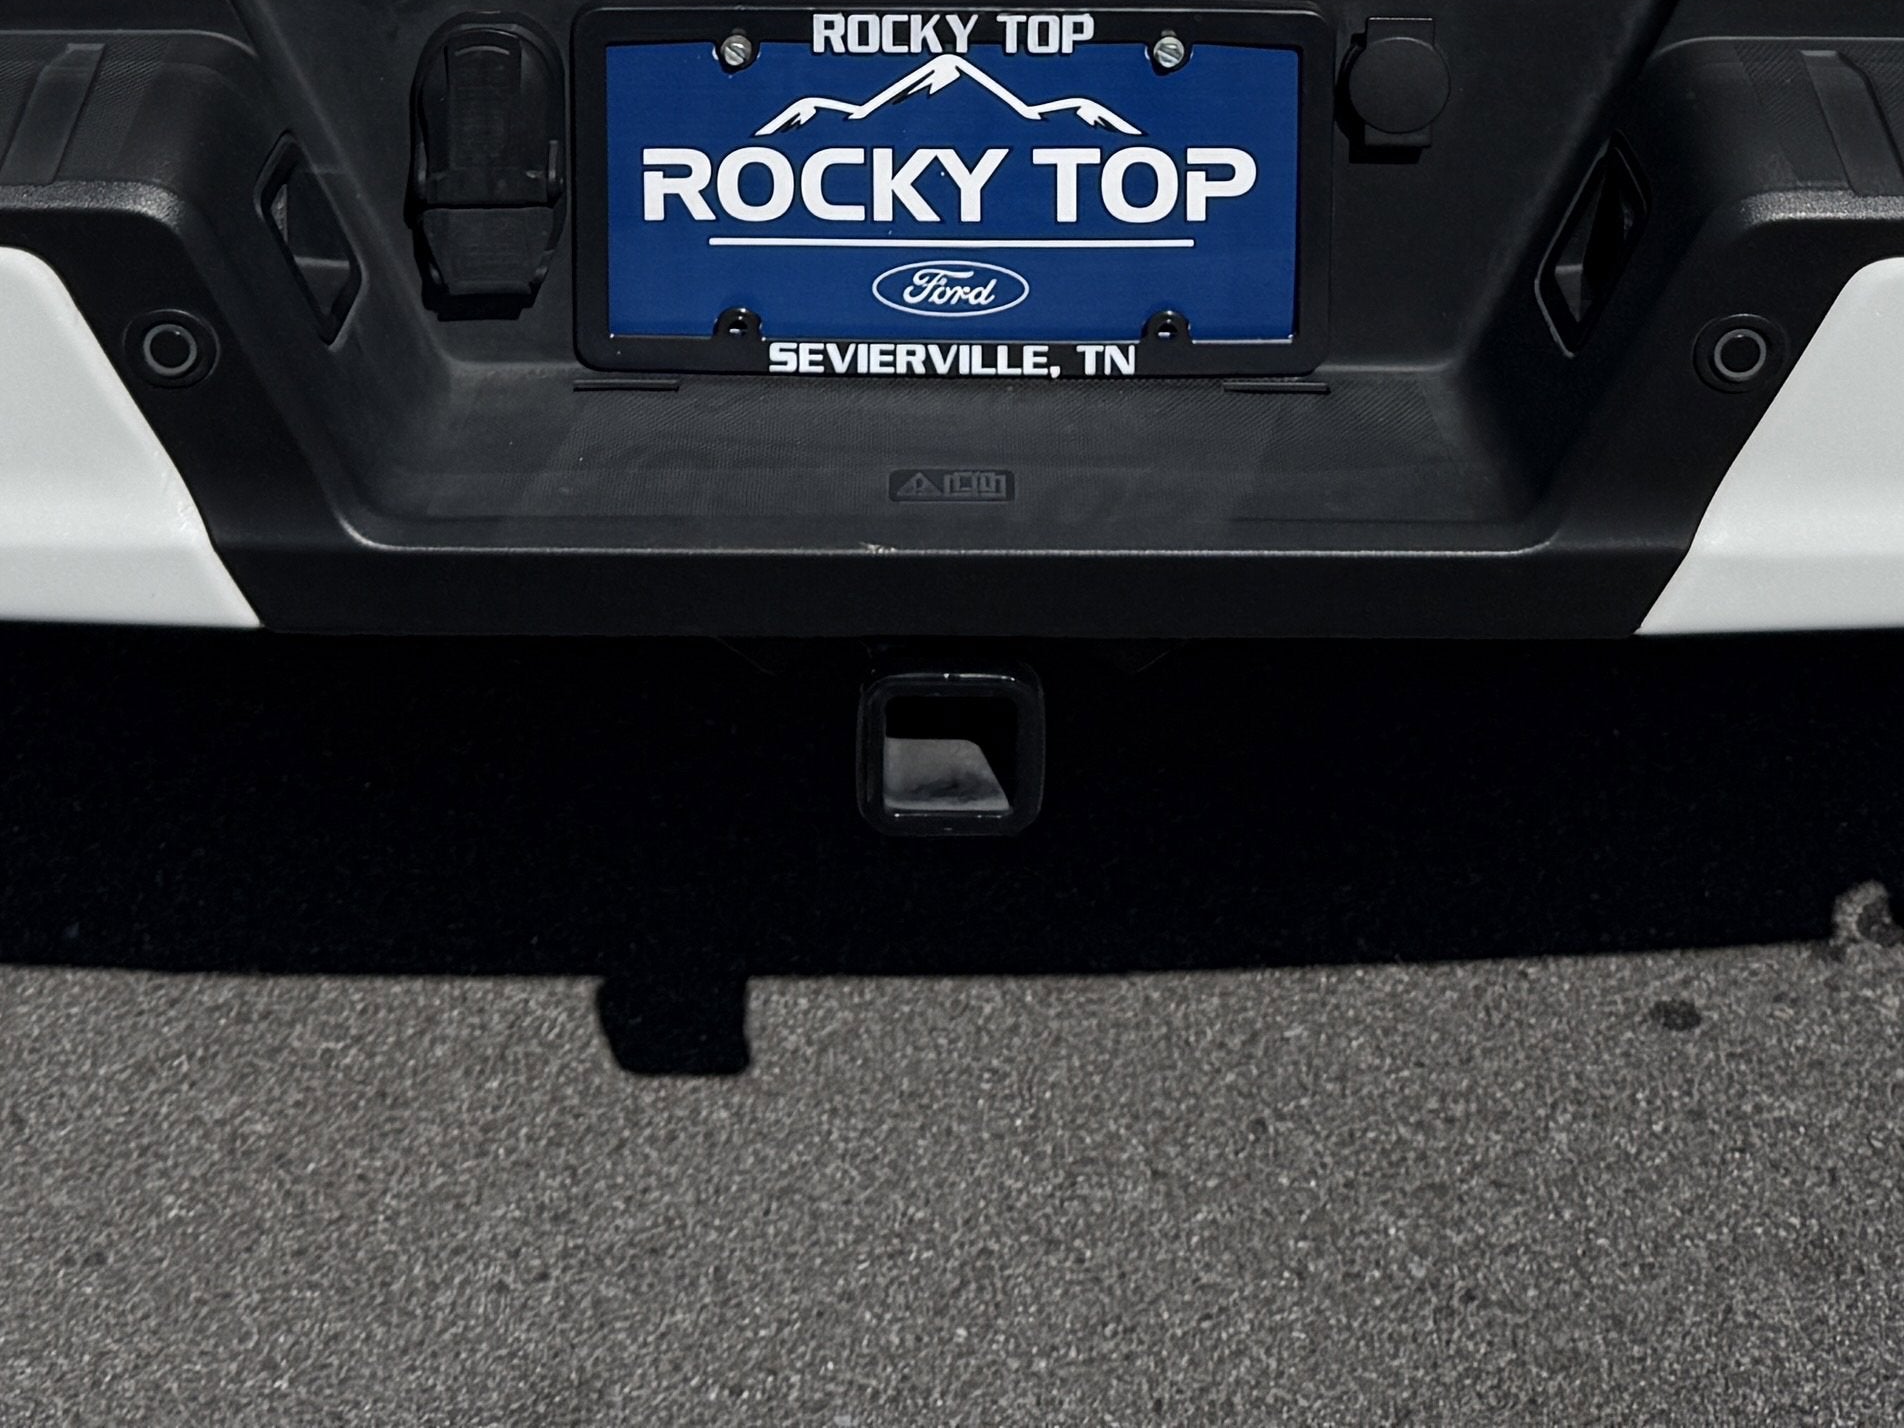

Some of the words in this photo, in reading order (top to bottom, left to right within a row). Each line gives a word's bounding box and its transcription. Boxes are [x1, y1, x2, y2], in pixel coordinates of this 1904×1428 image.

[812, 13, 980, 54] ROCKY
[996, 13, 1094, 54] TOP
[642, 147, 1009, 222] ROCKY
[1032, 147, 1257, 223] TOP
[902, 269, 996, 306] Ford
[768, 342, 1061, 378] SEVIERVILLE,
[1076, 344, 1137, 376] TN
